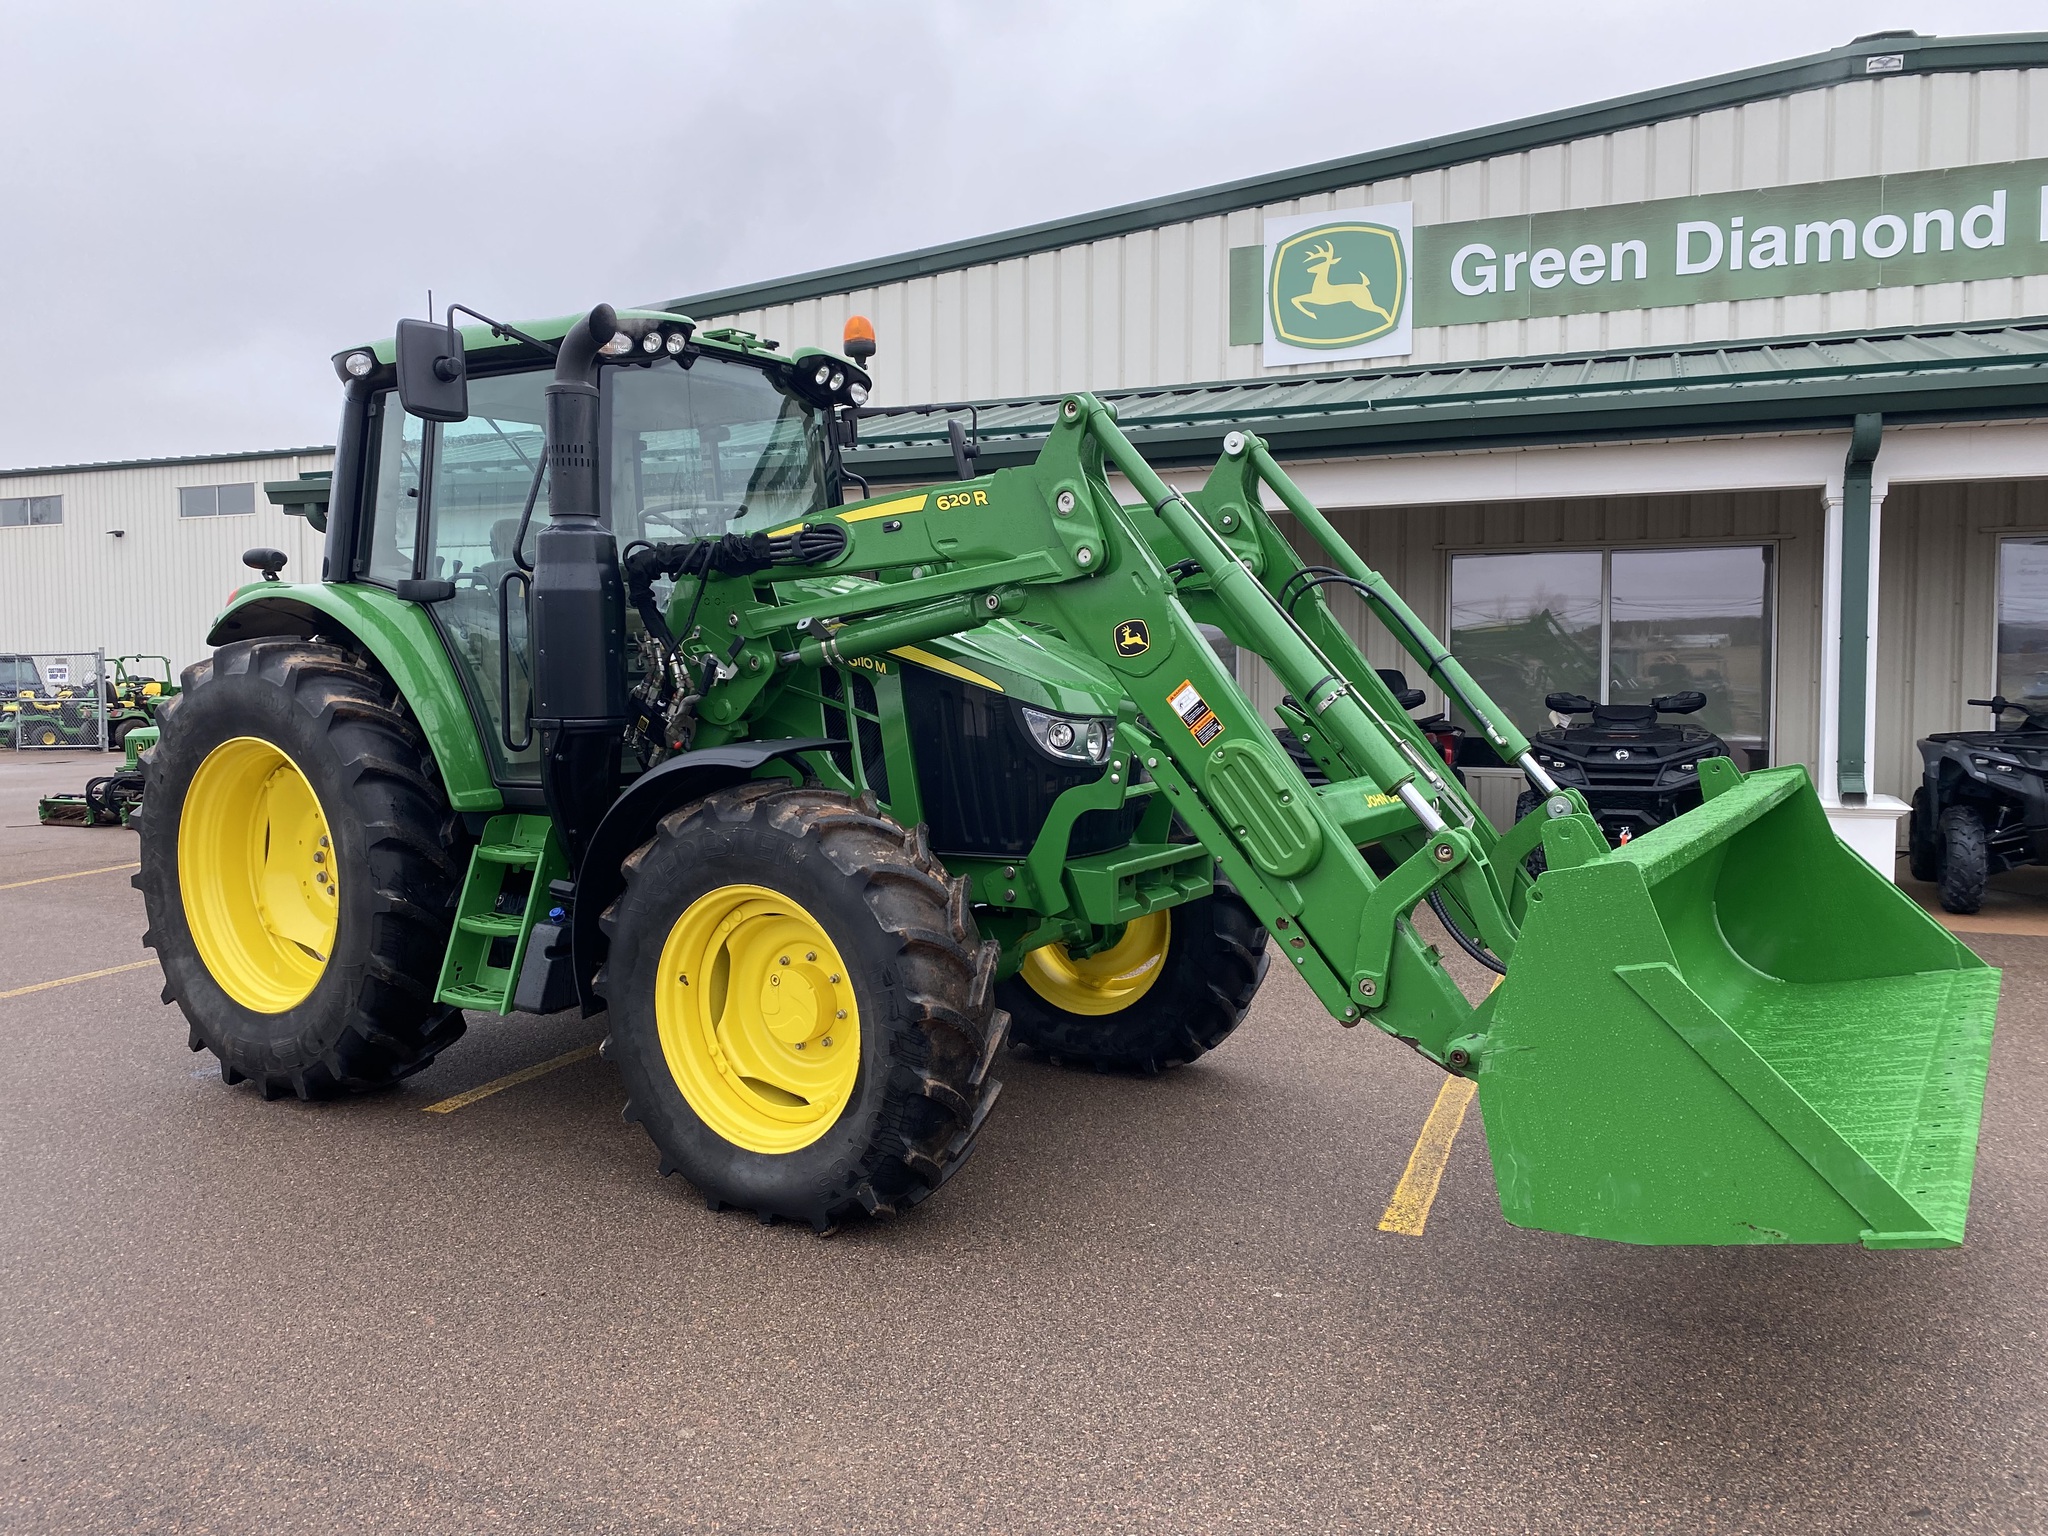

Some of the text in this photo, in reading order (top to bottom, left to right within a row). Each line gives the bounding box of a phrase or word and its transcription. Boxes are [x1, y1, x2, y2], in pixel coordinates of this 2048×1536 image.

[1450, 239, 1648, 296] Green
[1675, 189, 2007, 275] Diamond
[936, 489, 990, 511] 620 R
[874, 660, 888, 675] M
[1363, 792, 1389, 808] JOHN
